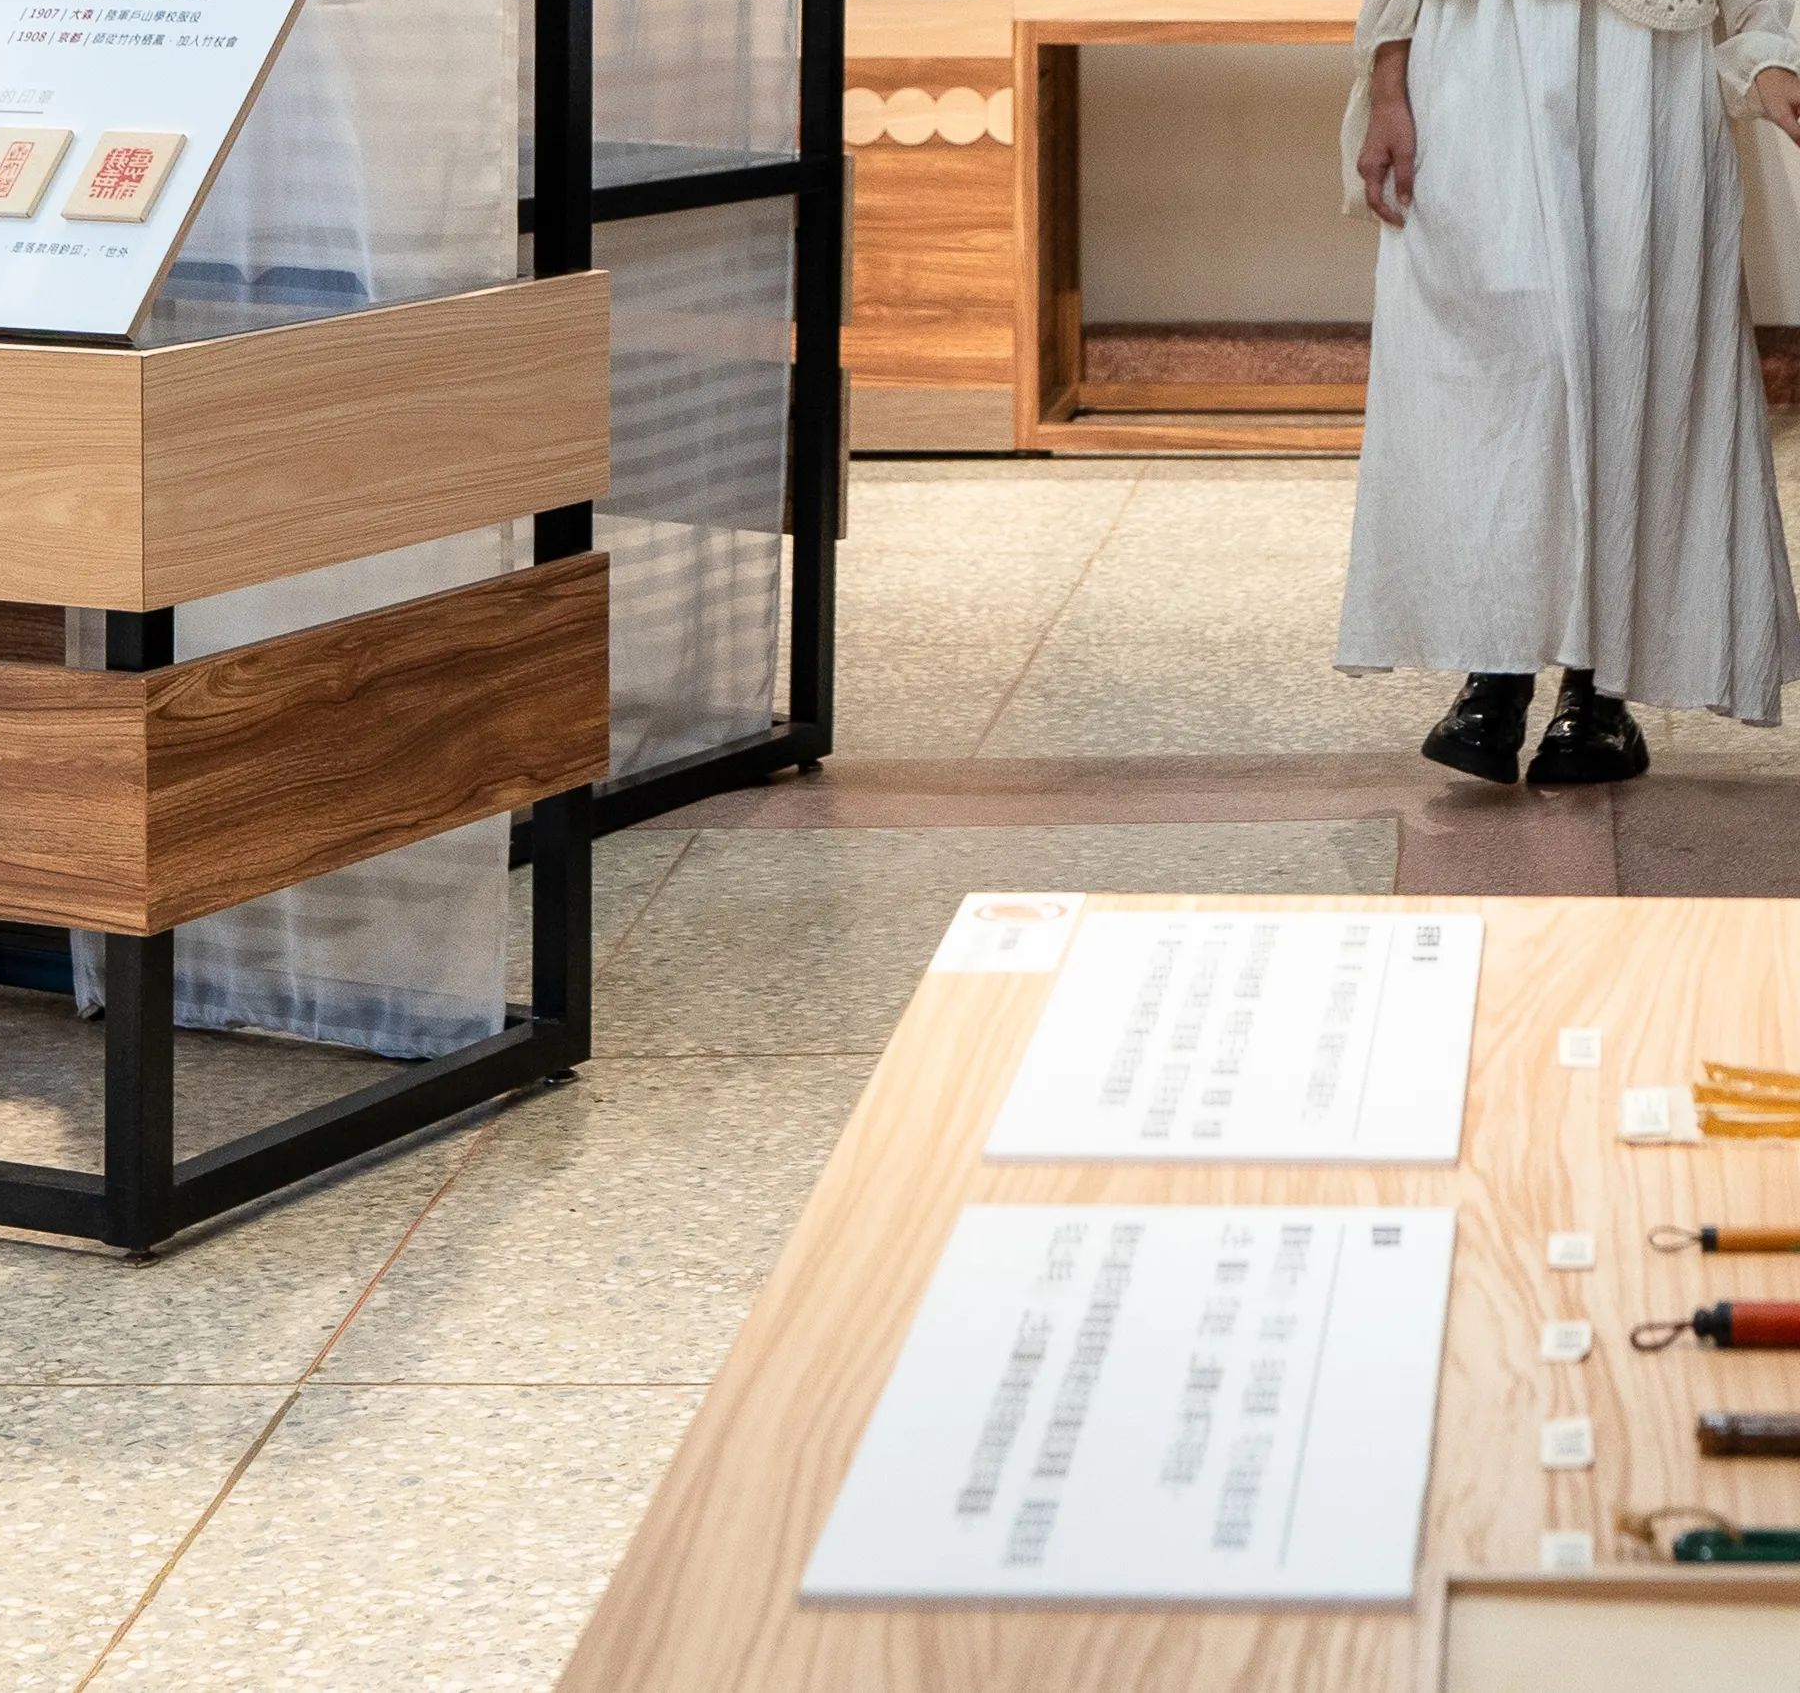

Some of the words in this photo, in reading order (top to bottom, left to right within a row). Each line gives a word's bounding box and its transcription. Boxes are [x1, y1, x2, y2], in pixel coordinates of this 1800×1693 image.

[29, 8, 61, 20] 1907
[70, 8, 95, 21] 大森
[16, 31, 48, 43] 1908
[57, 31, 83, 44] 京都
